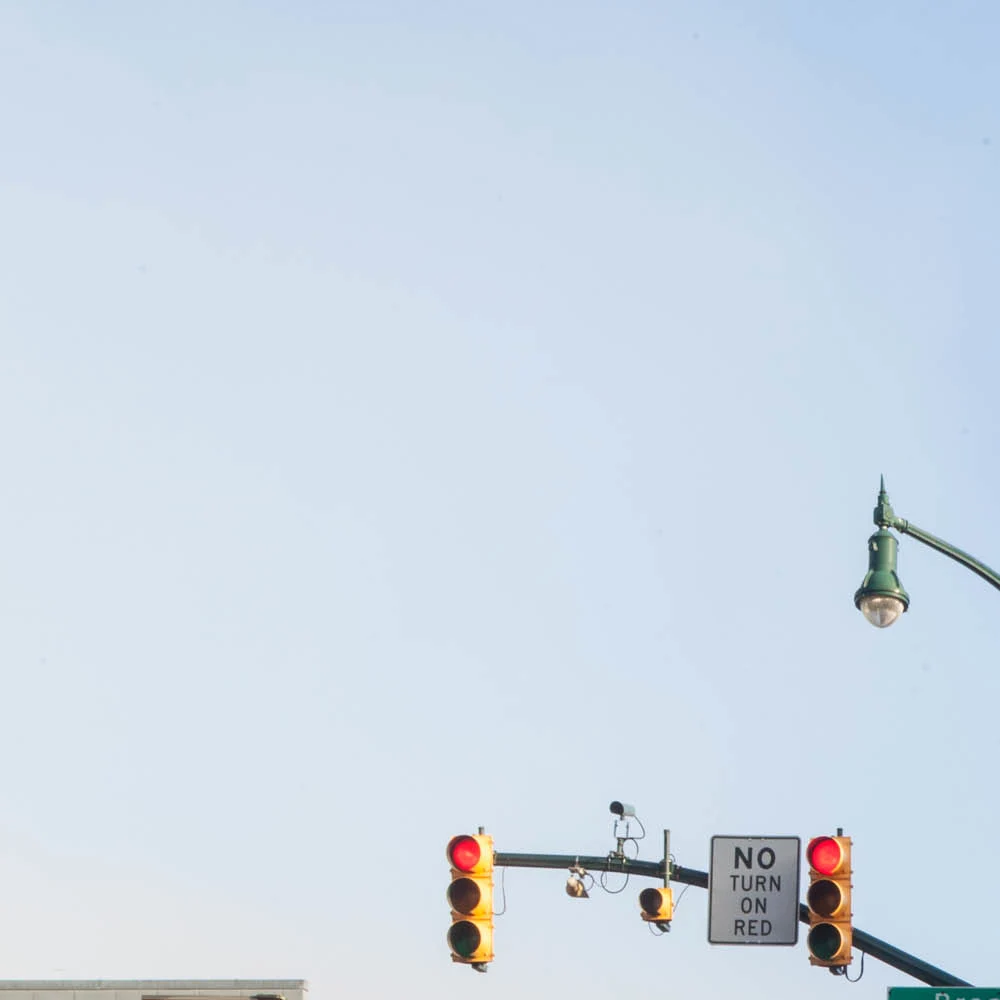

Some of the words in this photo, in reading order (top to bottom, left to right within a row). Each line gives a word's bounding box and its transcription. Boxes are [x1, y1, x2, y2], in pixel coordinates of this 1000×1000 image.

[734, 847, 775, 869] NO
[730, 875, 781, 892] TURN
[741, 897, 767, 914] ON
[734, 919, 772, 936] RED
